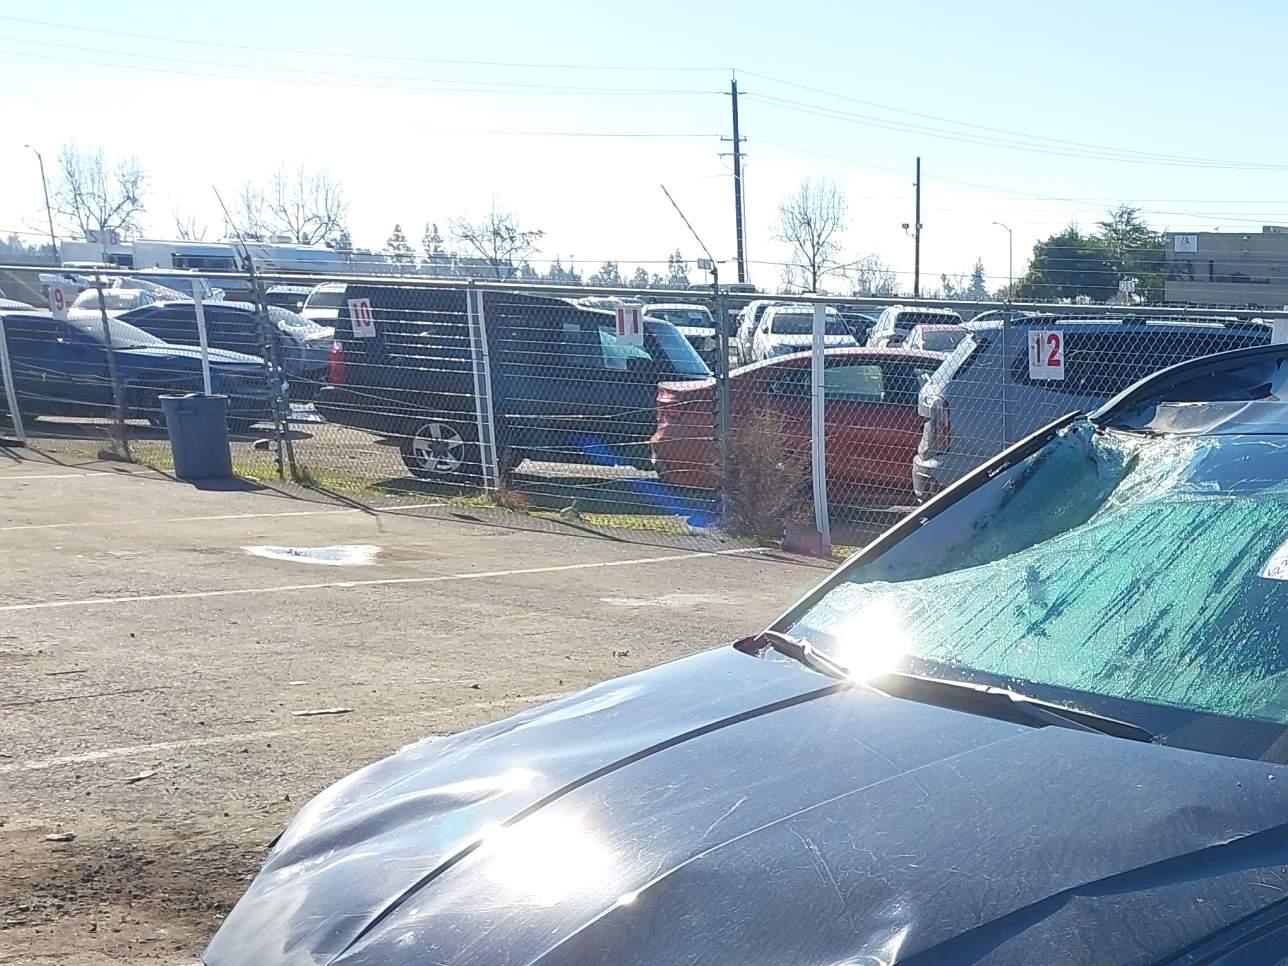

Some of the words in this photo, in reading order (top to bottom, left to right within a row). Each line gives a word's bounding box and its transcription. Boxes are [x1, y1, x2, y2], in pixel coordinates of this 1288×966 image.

[54, 288, 65, 311] 9
[353, 301, 371, 327] 10
[1035, 333, 1062, 367] 12
